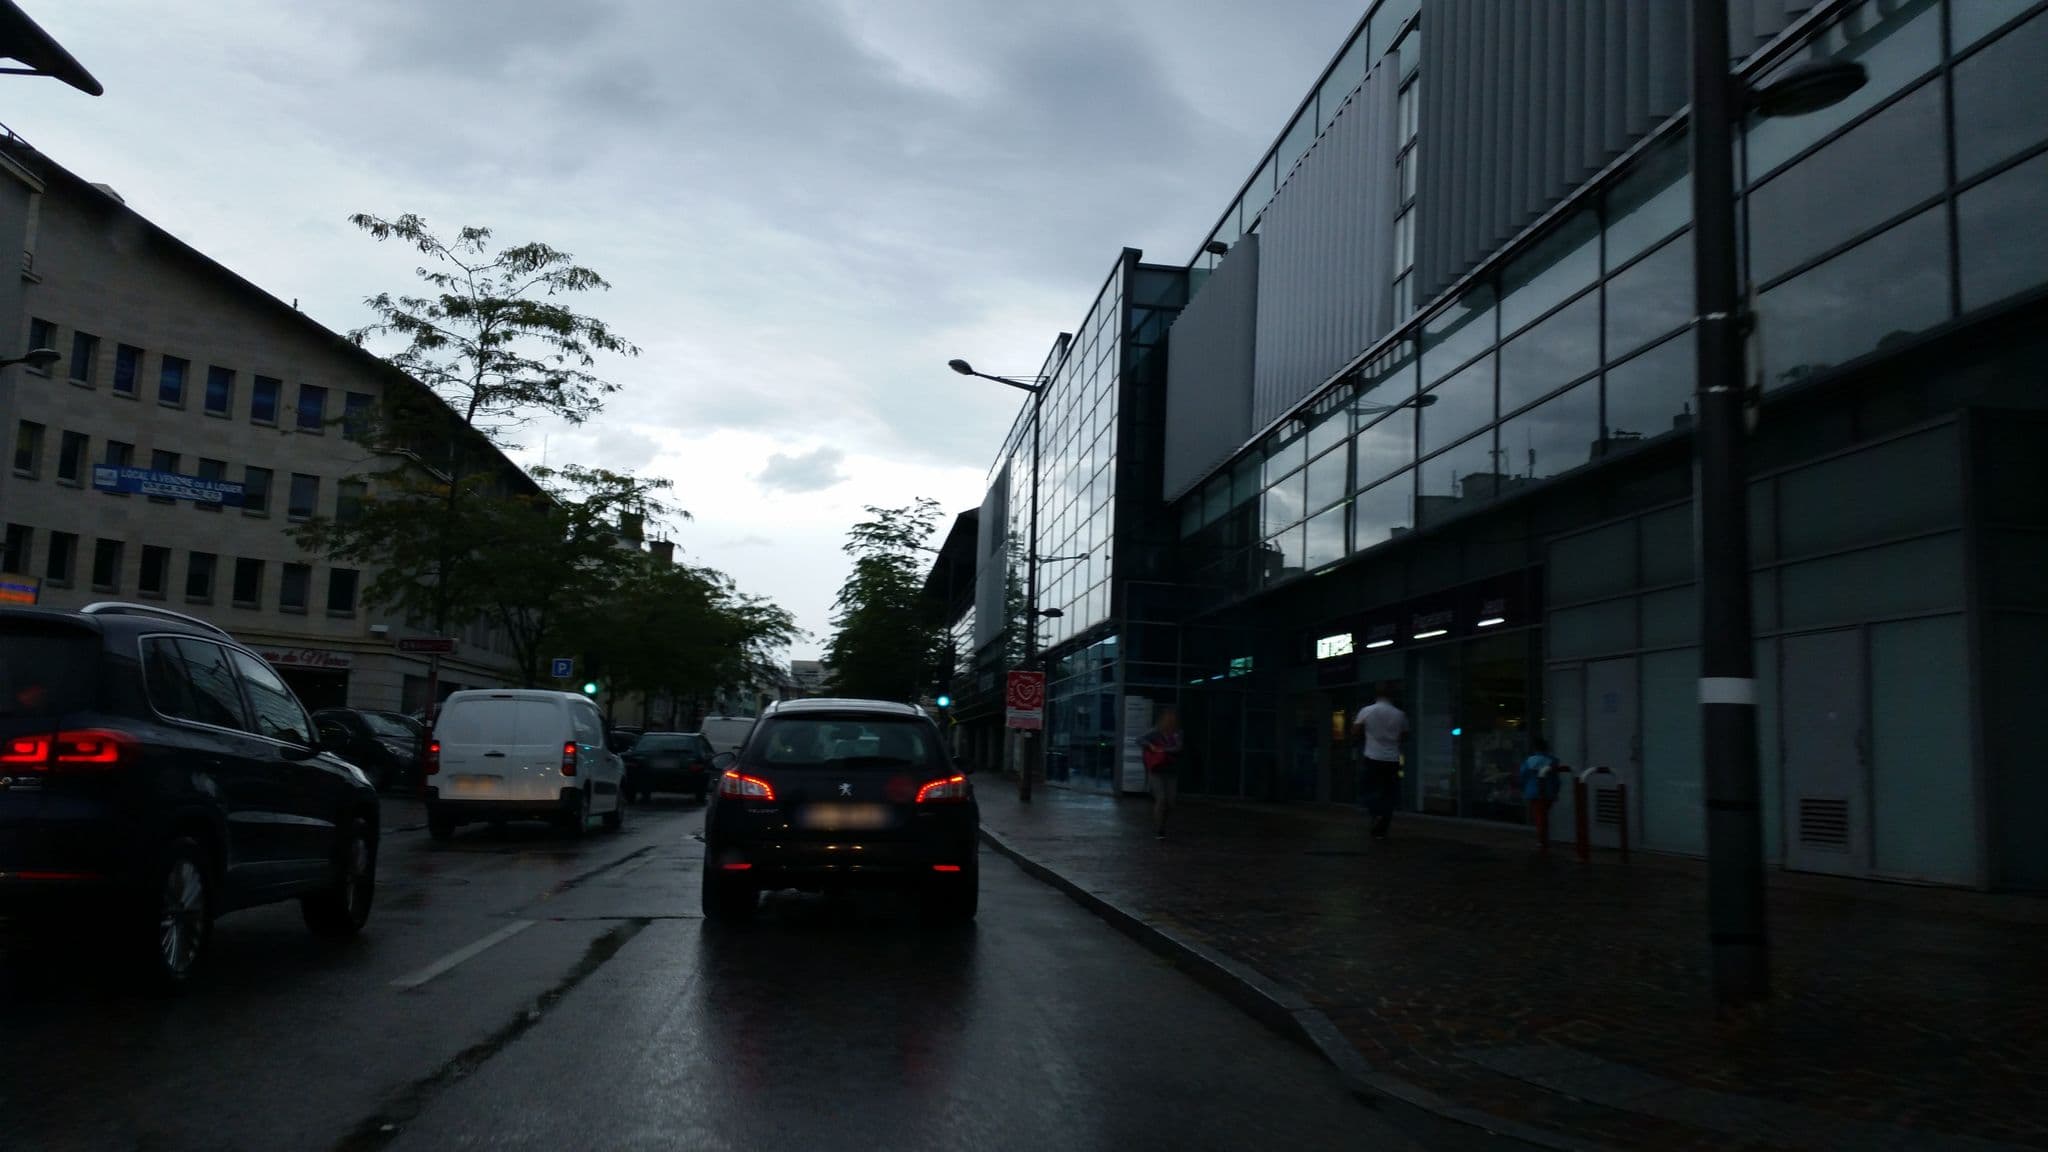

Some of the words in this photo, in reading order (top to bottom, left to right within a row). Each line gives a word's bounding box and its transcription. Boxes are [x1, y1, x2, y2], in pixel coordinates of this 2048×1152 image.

[121, 469, 149, 481] LOCAL
[159, 473, 193, 487] VENDRE
[214, 482, 243, 494] LOUER
